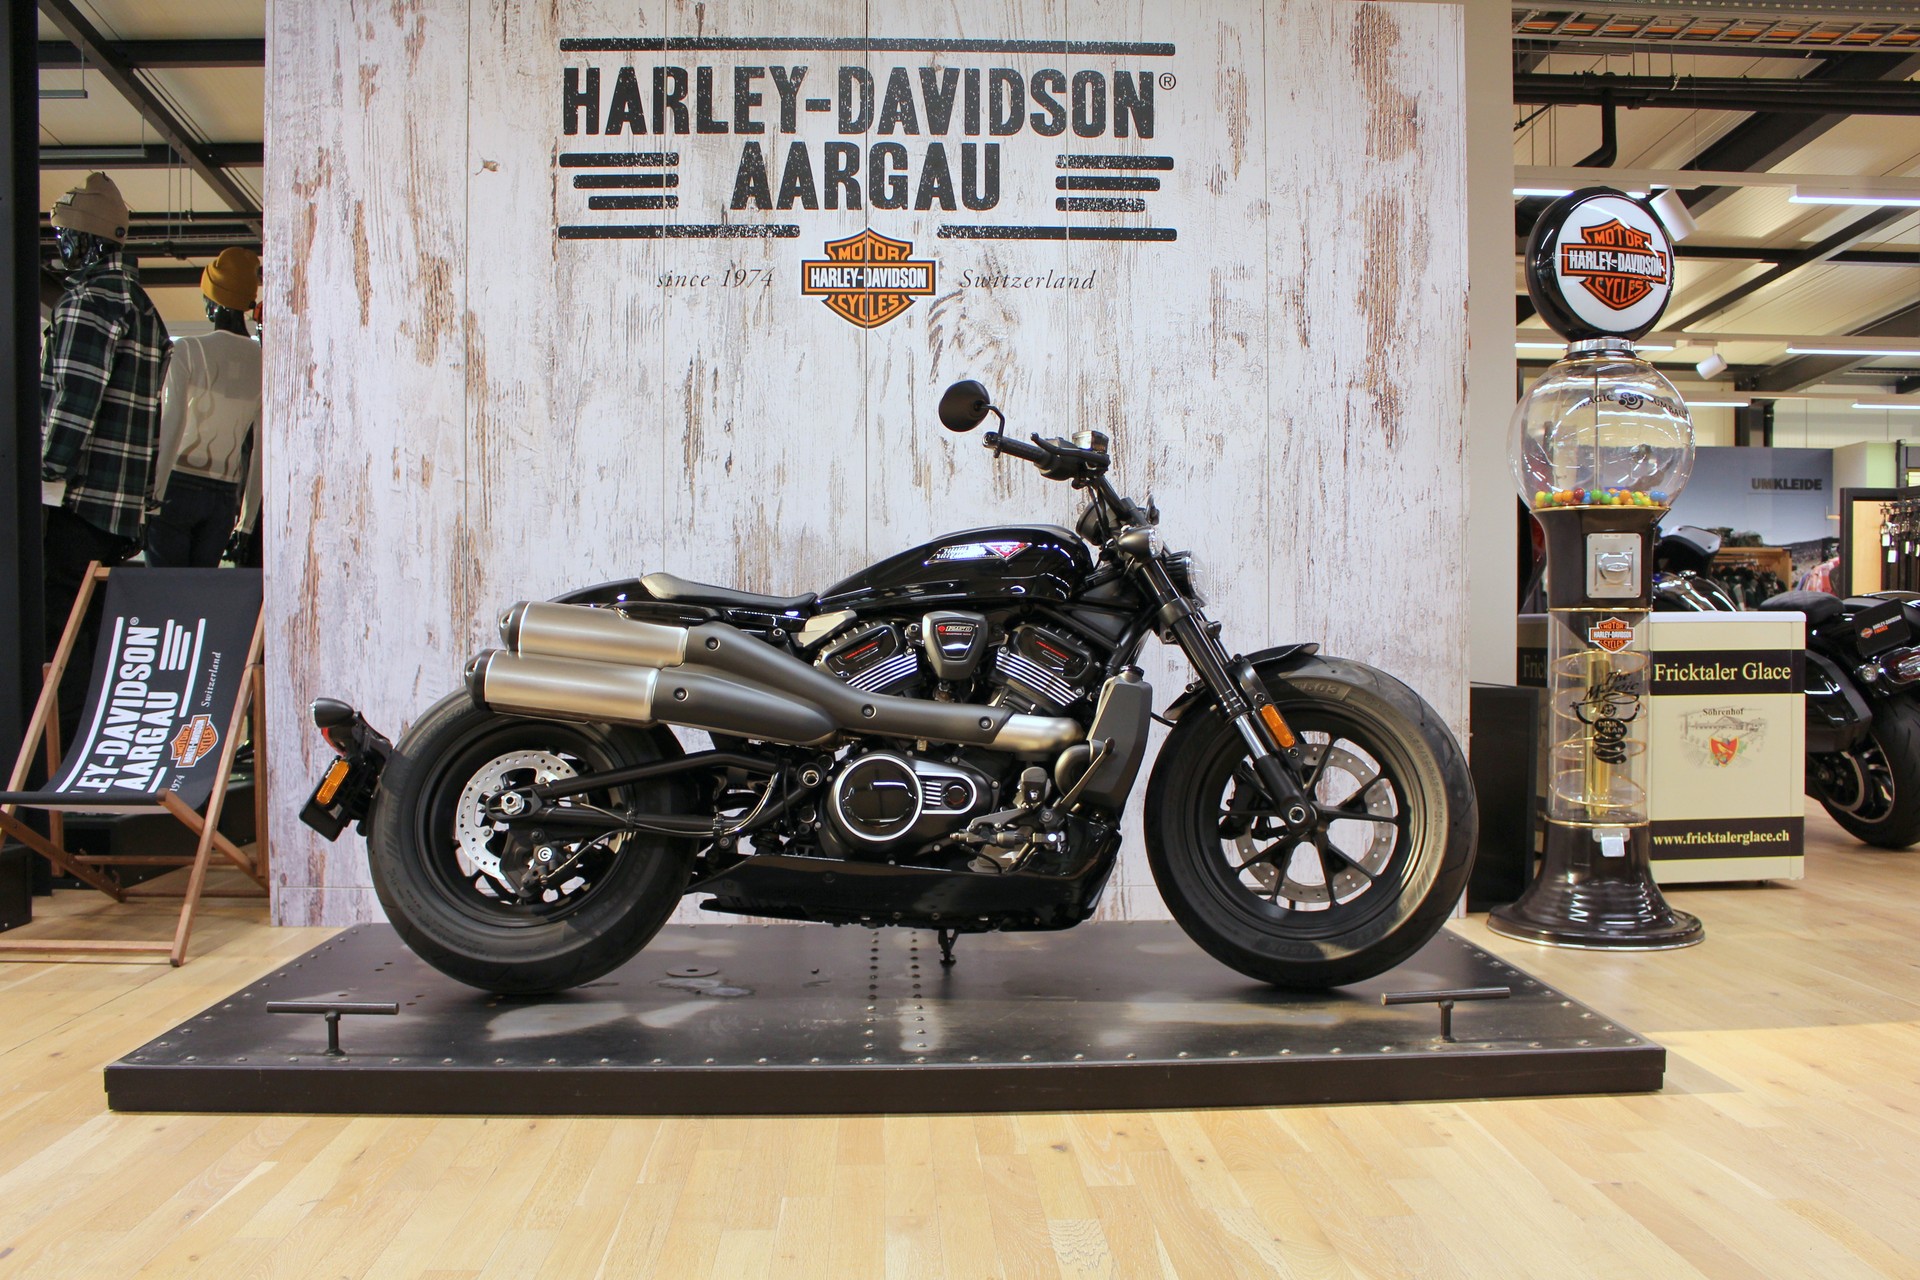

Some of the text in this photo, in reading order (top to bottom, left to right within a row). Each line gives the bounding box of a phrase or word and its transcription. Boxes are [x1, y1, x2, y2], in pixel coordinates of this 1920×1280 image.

[729, 141, 1001, 211] AARGAU
[1594, 227, 1644, 248] MOTOR
[838, 239, 901, 261] MOTOR
[1569, 250, 1663, 276] HARLEY-DAVIDSON
[656, 266, 776, 288] since 1974
[810, 267, 927, 288] HARLEY-DAVIDSON
[959, 268, 1097, 290] Switzerland
[1594, 277, 1644, 303] CYCLES
[837, 294, 900, 321] CYCLES
[1752, 478, 1823, 491] UMKLEIDE
[201, 651, 221, 708] Switzerland
[1654, 662, 1791, 682] Fricktaler Glace
[1702, 707, 1744, 716] Söhrenhof
[113, 691, 178, 791] AARGAU
[169, 774, 185, 792] 1974
[1653, 829, 1790, 846] www.fricktalerglace.ch
